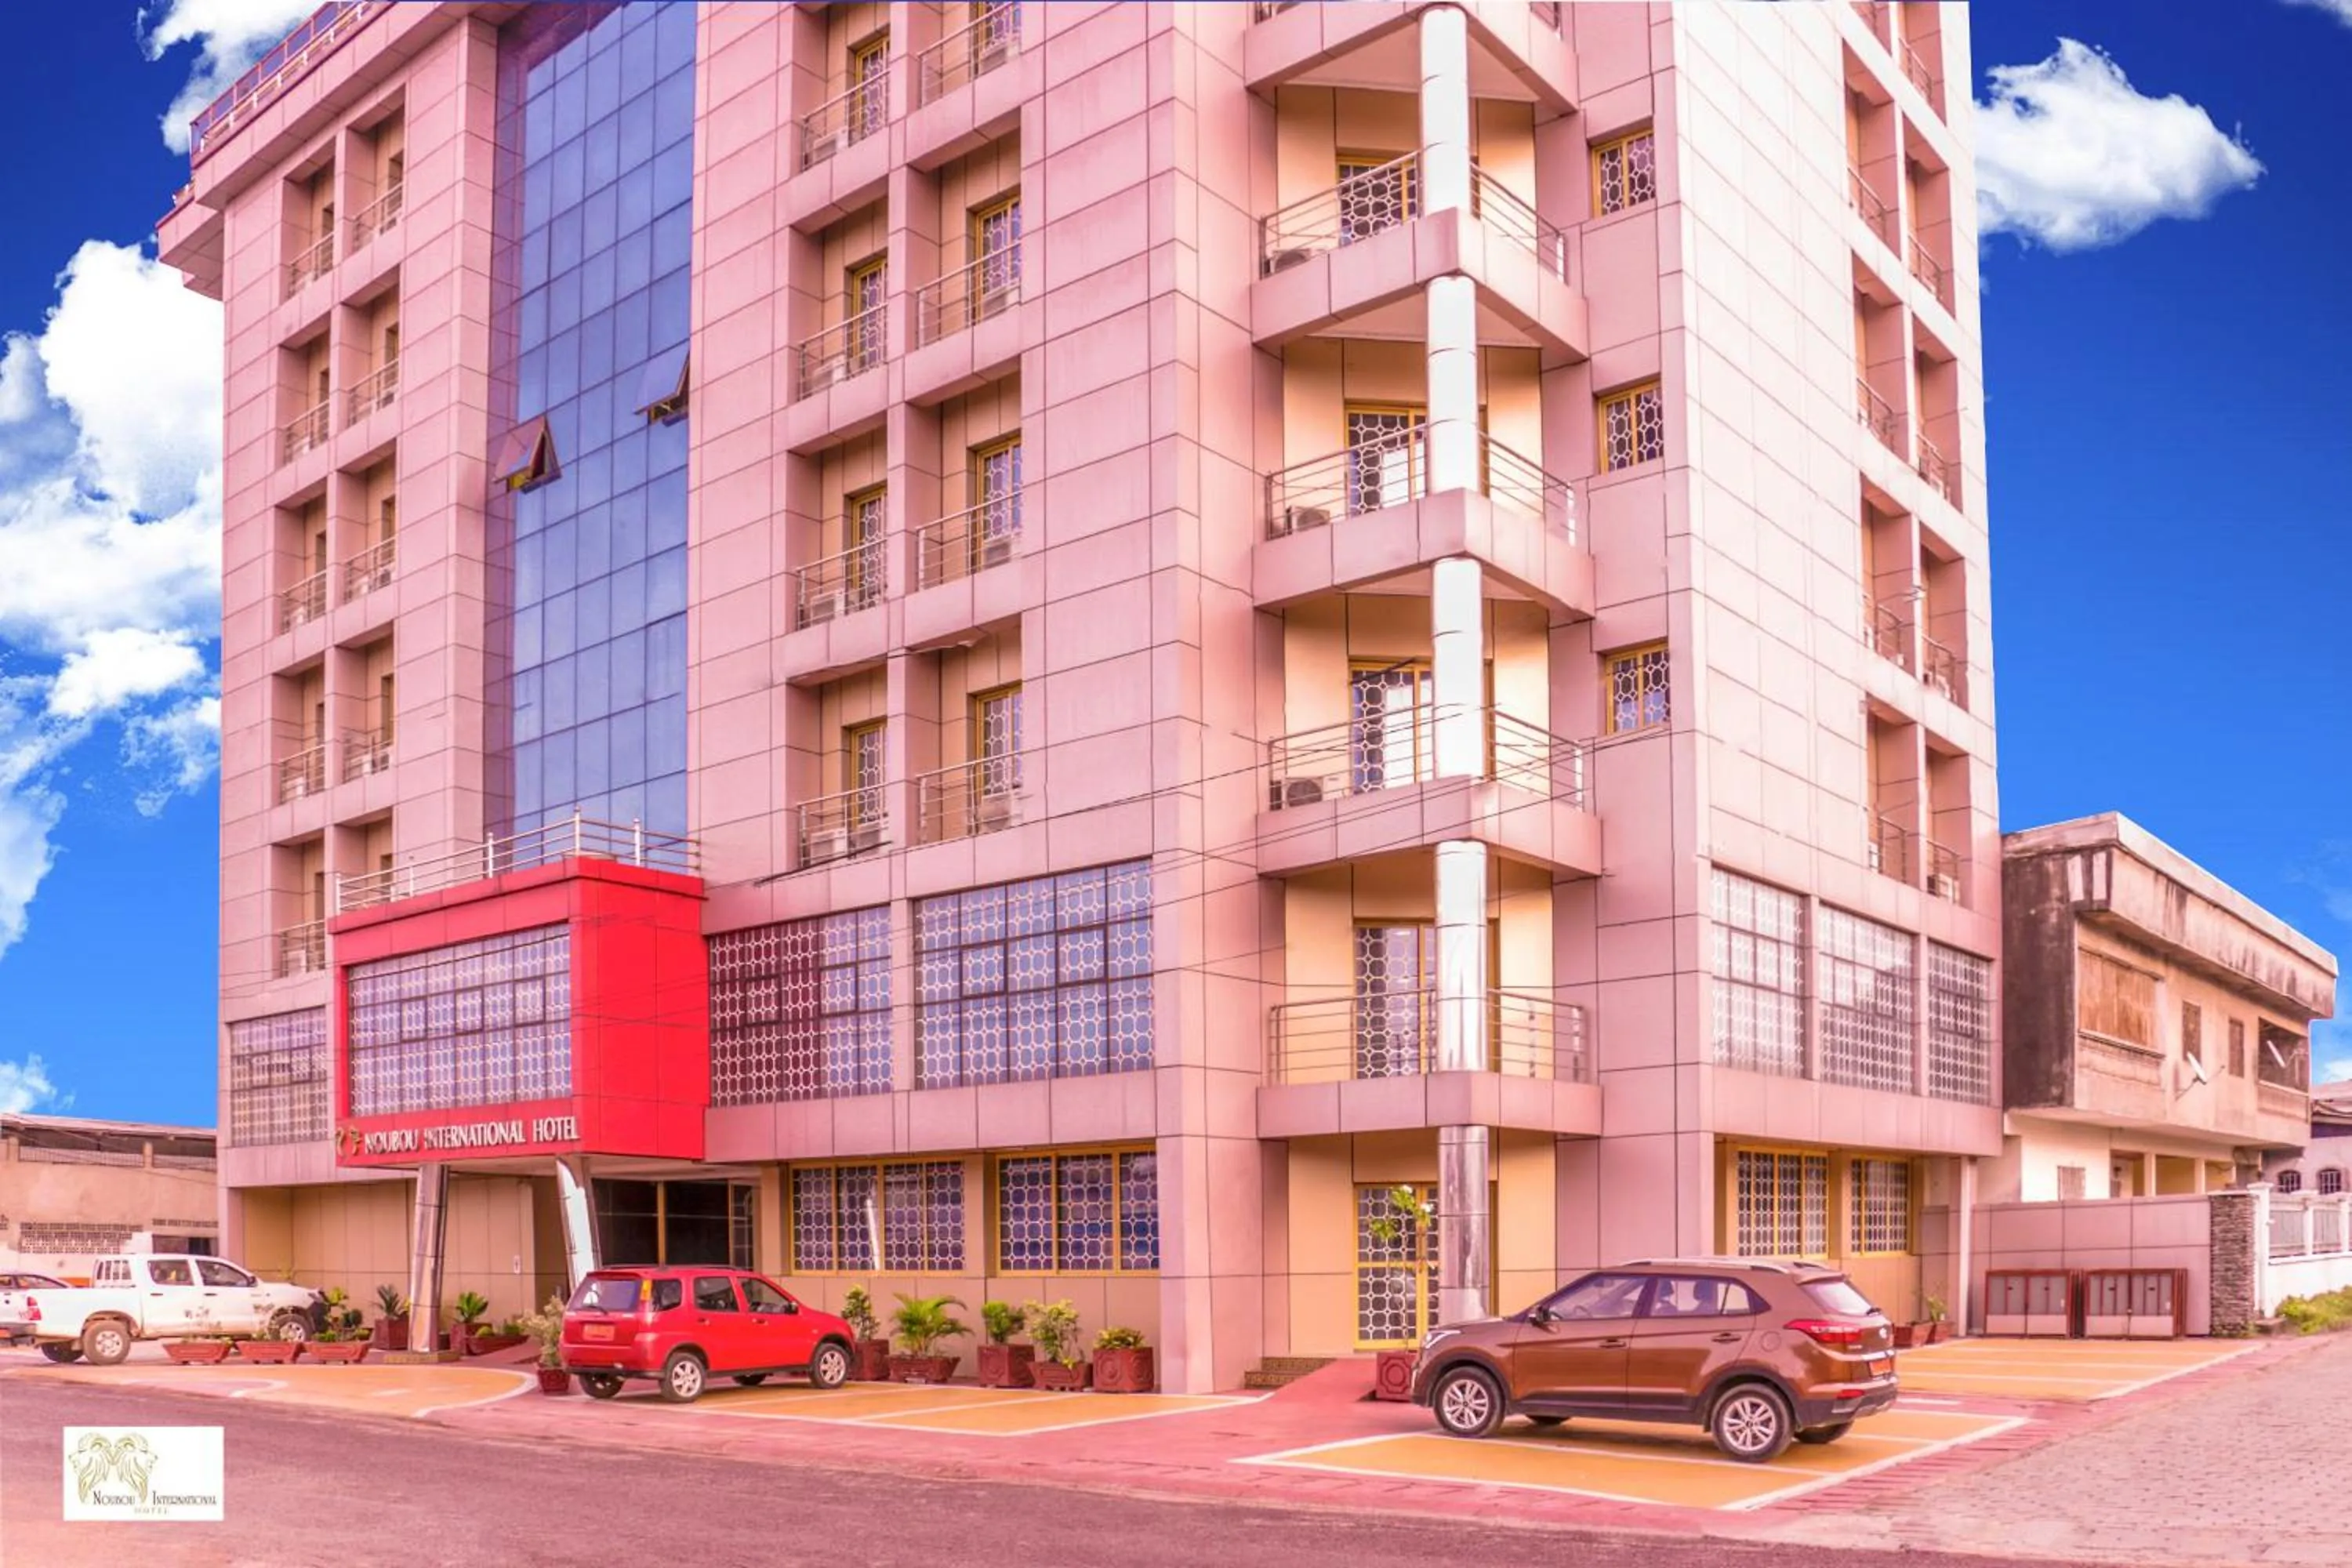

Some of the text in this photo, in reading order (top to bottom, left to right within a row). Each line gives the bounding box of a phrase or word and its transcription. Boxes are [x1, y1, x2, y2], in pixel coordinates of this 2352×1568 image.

[364, 1116, 580, 1154] NOUBOU INTERNATIONAL HOTEL
